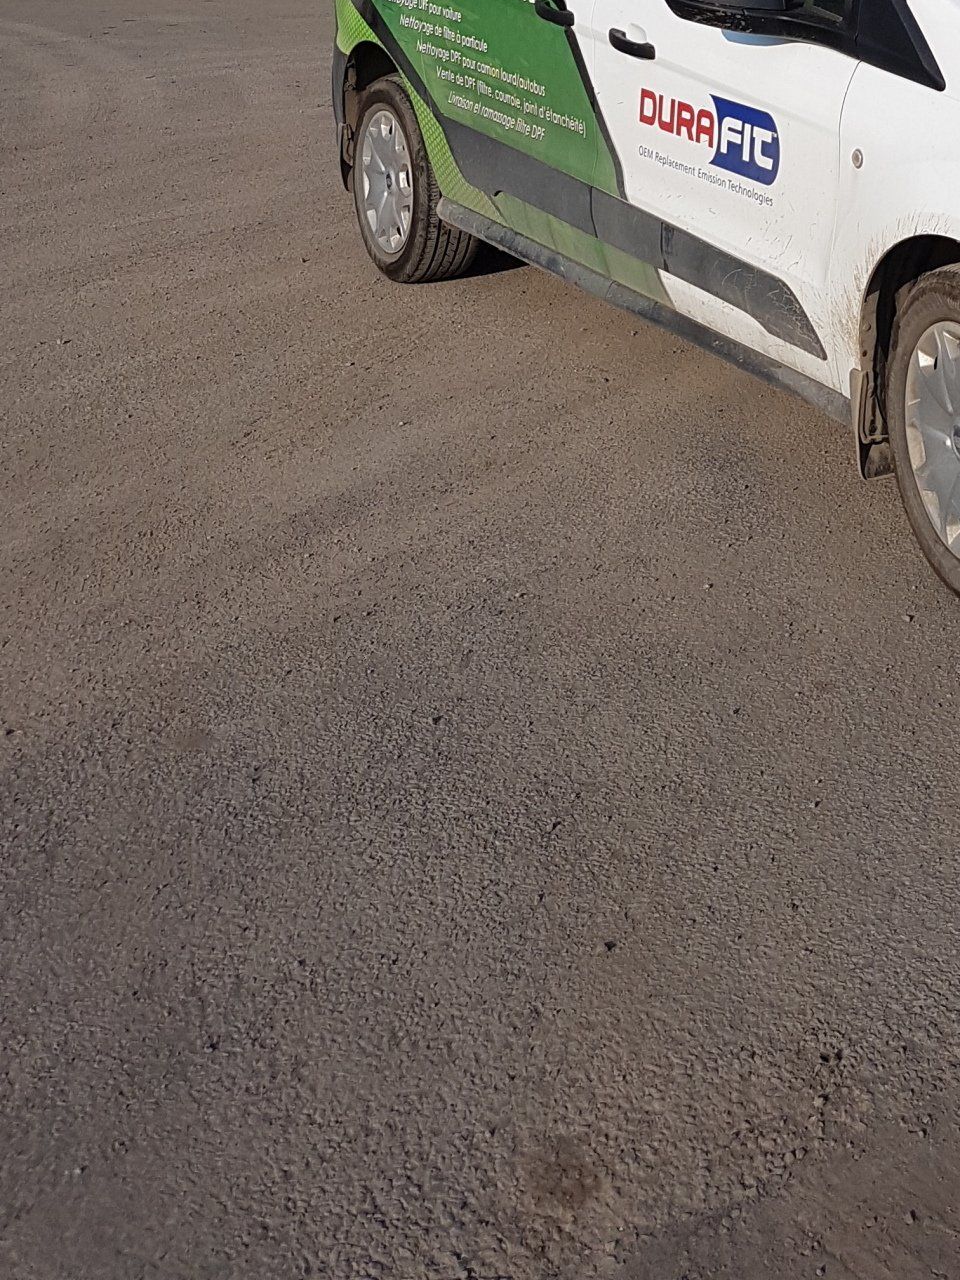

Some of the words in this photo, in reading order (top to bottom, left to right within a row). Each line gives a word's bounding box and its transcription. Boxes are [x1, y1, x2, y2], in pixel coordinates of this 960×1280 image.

[399, 13, 434, 35] Nettoyage
[434, 24, 443, 36] de
[462, 35, 488, 53] particule
[428, 3, 442, 15] pour
[442, 6, 462, 22] voiture
[416, 39, 450, 62] Nettoyage
[450, 49, 462, 64] DPF
[462, 57, 476, 69] pour
[476, 62, 500, 79] camion
[500, 67, 546, 97] lourd/autobus
[436, 65, 455, 83] Vente
[455, 73, 464, 86] de
[464, 75, 475, 91] DPF
[494, 90, 523, 110] courroie,
[523, 98, 538, 116] joint
[448, 91, 474, 111] Livraison
[481, 106, 516, 130] ramassage
[515, 117, 531, 136] filtre
[531, 125, 546, 141] DPF
[638, 145, 654, 160] OEM
[654, 151, 696, 177] Replacement
[697, 168, 727, 189] Emission
[727, 180, 774, 207] Technologies
